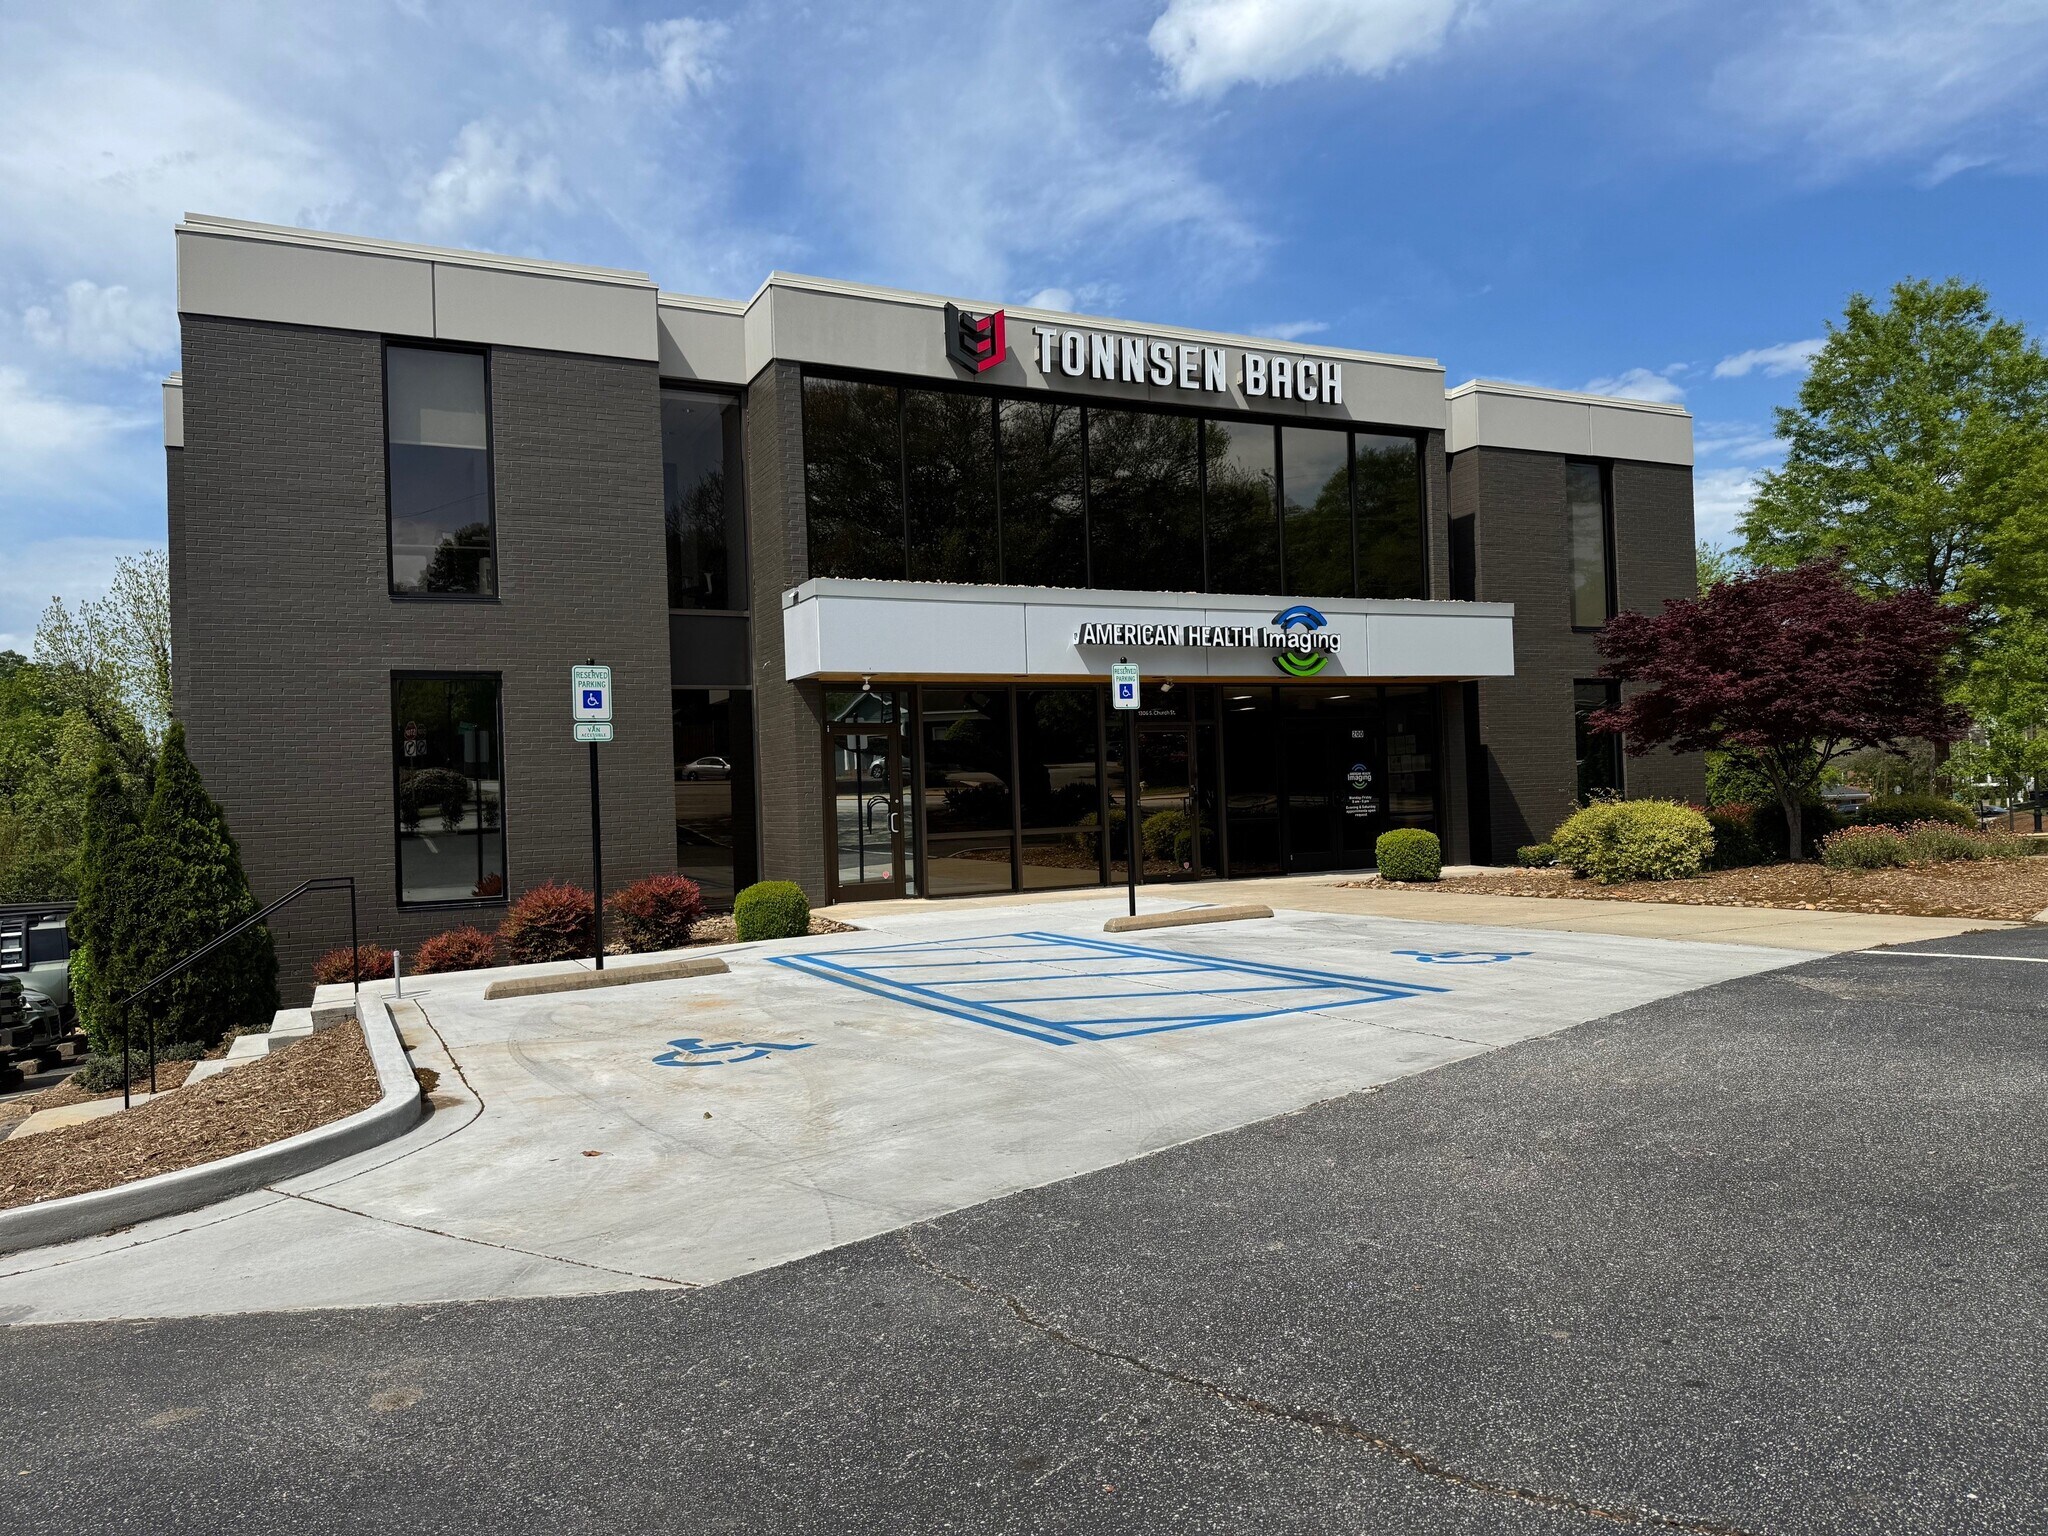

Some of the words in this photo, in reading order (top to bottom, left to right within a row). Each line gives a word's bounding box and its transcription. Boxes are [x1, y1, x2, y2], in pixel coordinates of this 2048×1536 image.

[1034, 325, 1226, 392] TONNSEN
[1242, 352, 1342, 404] BACH
[1081, 623, 1180, 646] AMERICAN
[1187, 626, 1253, 647] HEALTH
[1262, 627, 1341, 653] Imaging
